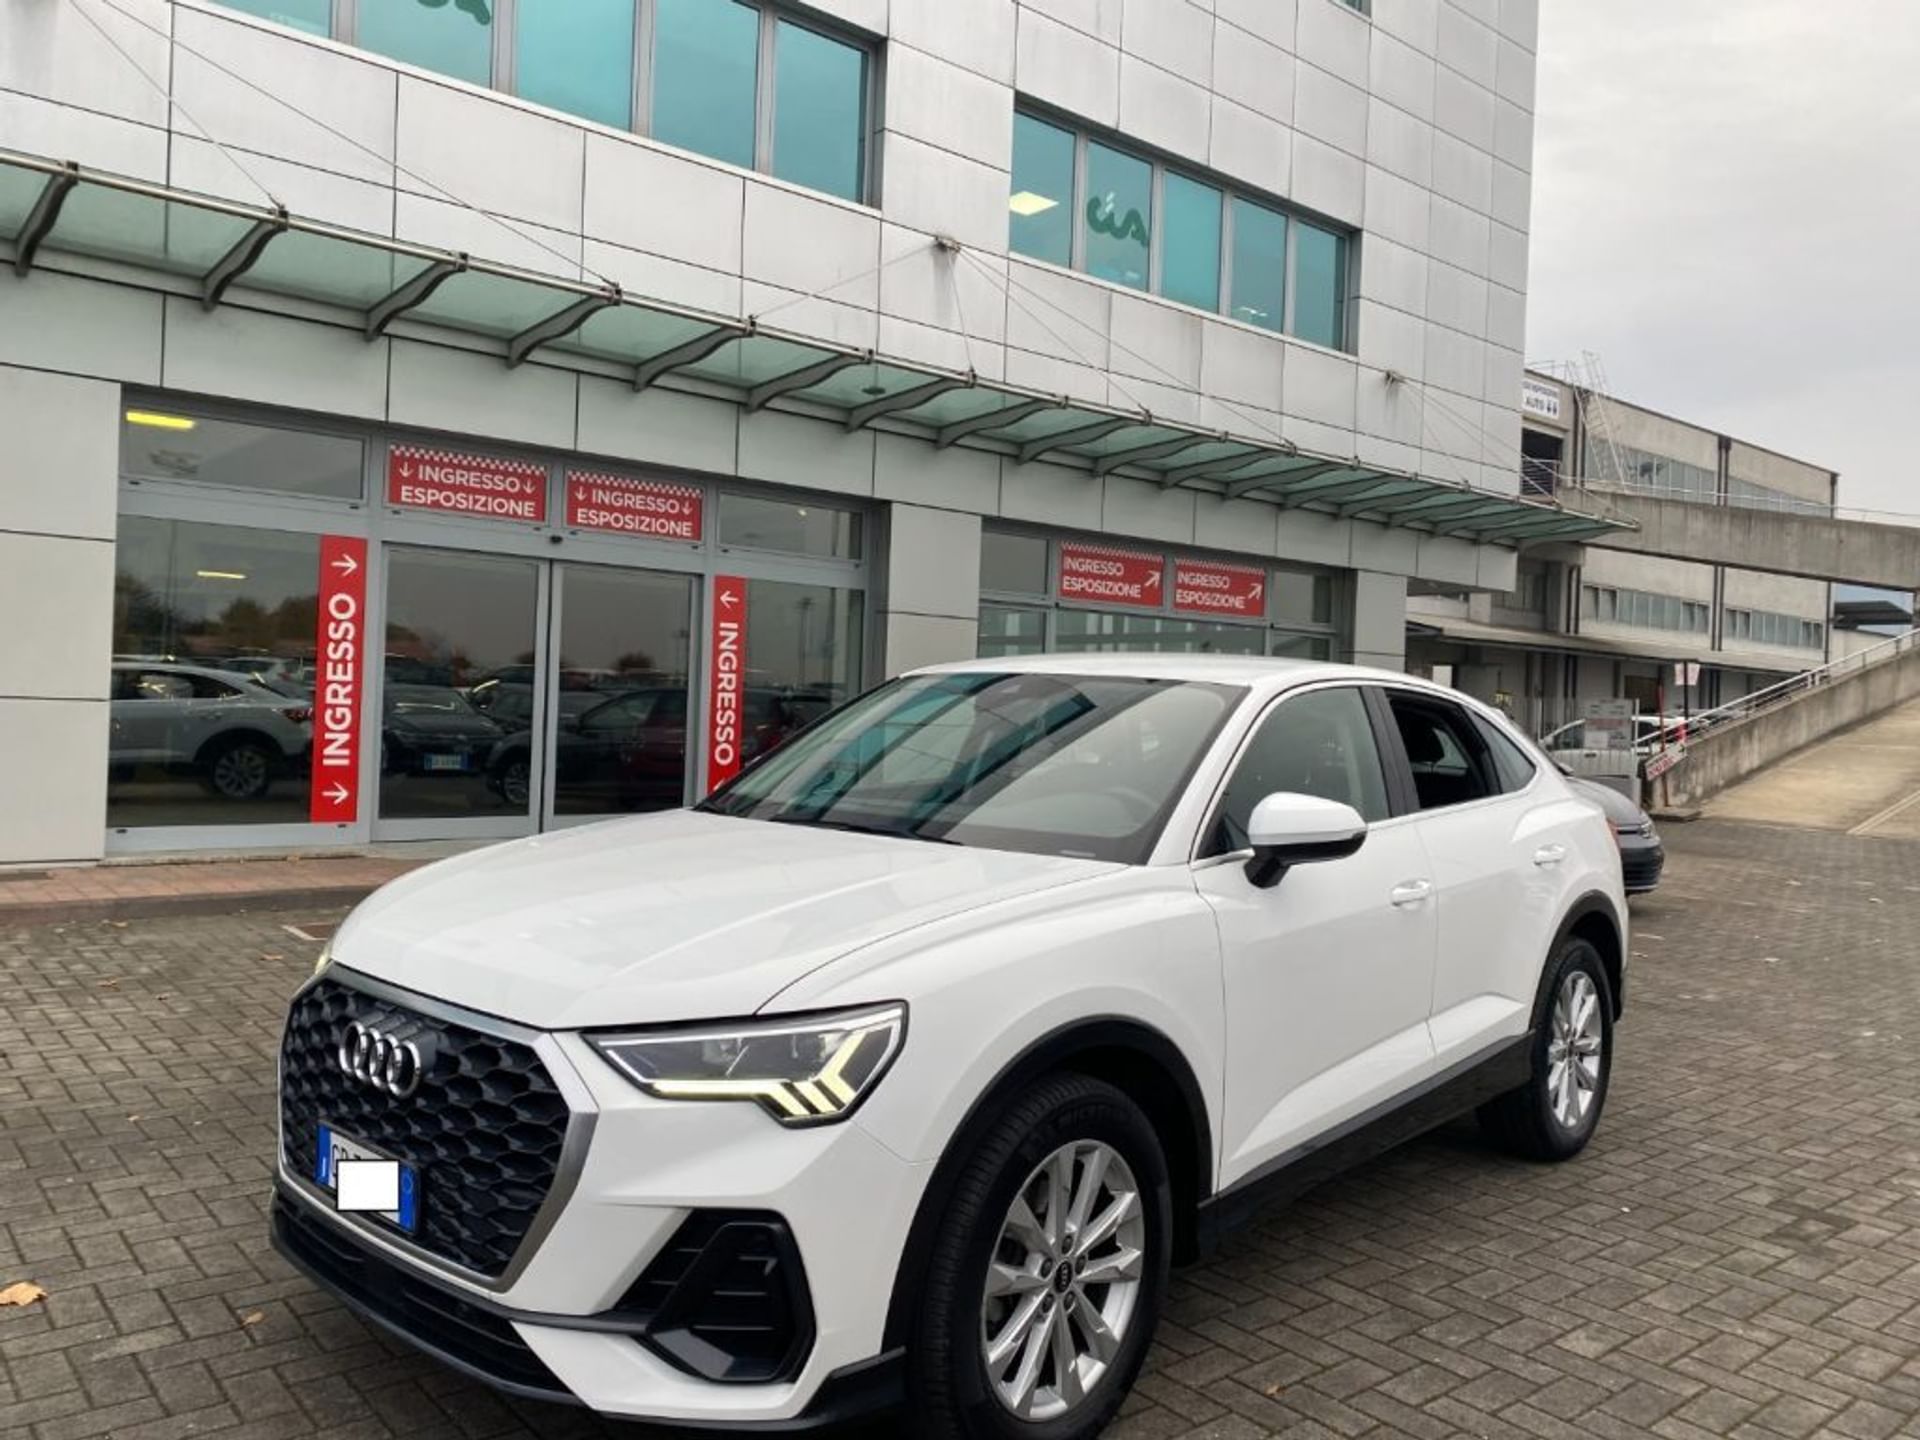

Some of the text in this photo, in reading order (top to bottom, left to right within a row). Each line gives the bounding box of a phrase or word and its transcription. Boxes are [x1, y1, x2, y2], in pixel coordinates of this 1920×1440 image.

[418, 464, 520, 493] INGRESSO
[400, 485, 536, 517] ESPOSIZIONE
[592, 488, 680, 514] INGRESSO
[577, 508, 693, 537] ESPOSIZIONE
[1063, 556, 1125, 577] INGRESSO
[1176, 571, 1231, 589] INGRESSO
[1062, 576, 1141, 599] ESPOSIZIONE
[1175, 588, 1246, 610] ESPOSIZIONE
[322, 592, 357, 766] INGRESSO
[714, 622, 740, 766] INGRESSO
